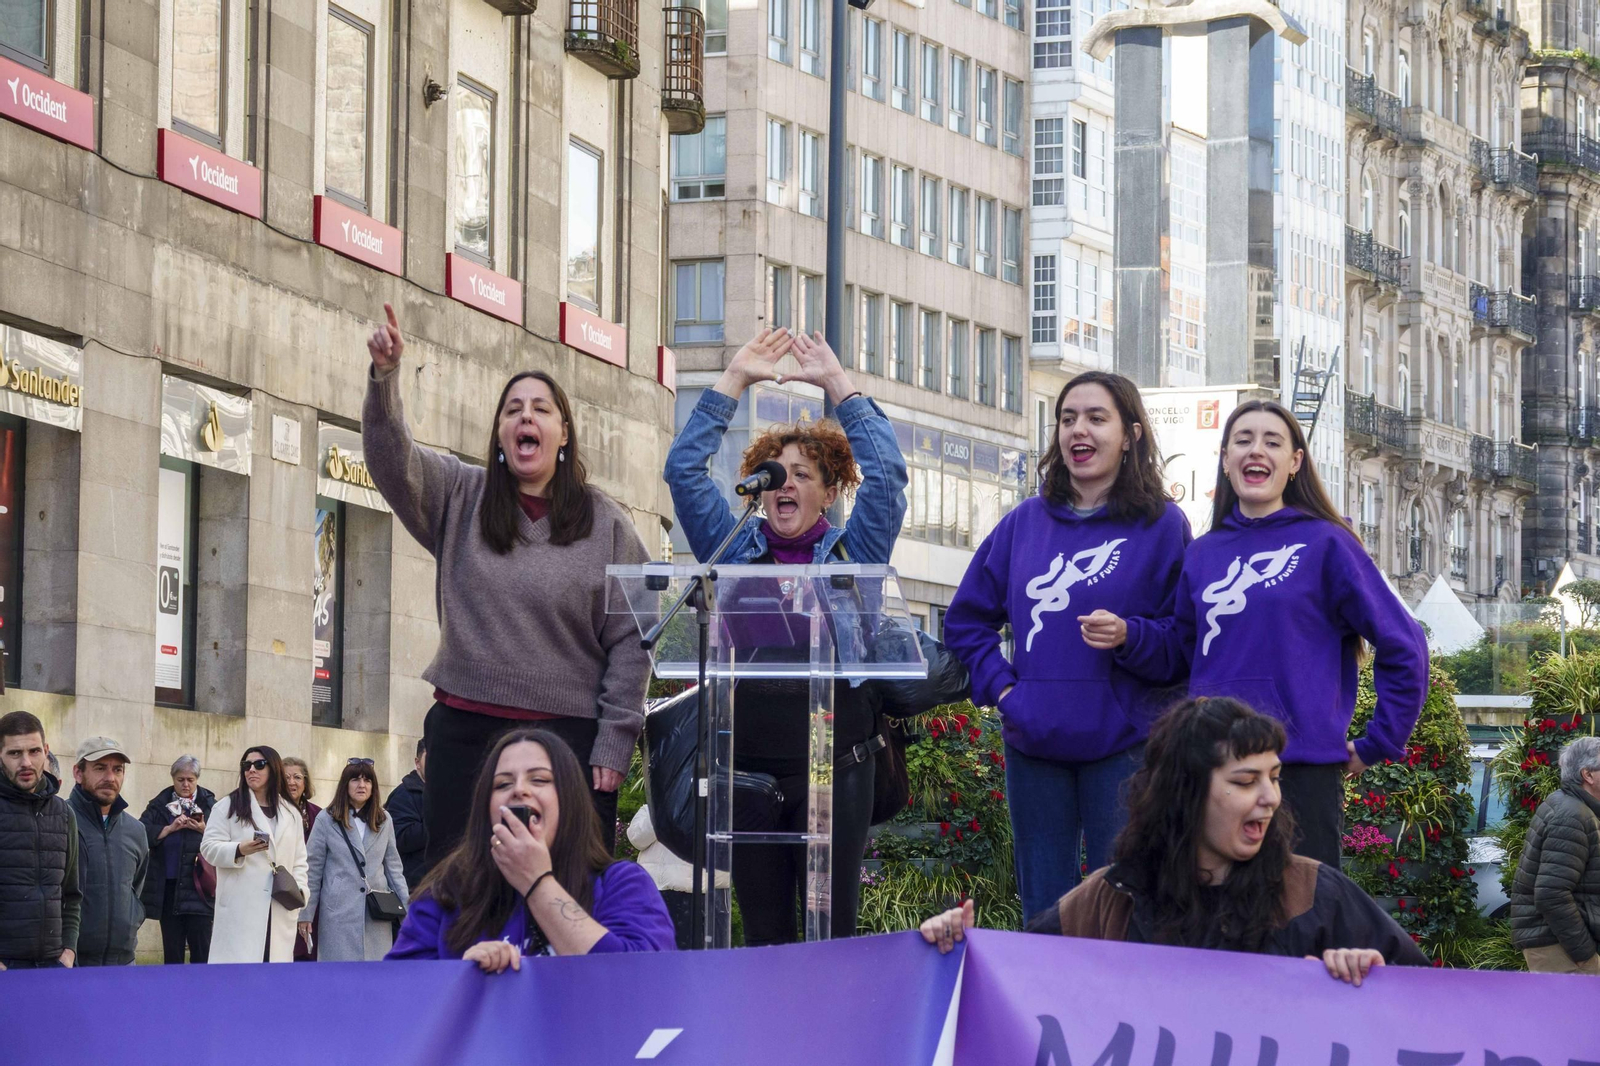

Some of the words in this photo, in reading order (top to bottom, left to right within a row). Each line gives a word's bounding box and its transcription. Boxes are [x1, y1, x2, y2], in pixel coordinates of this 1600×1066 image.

[22, 84, 67, 123] Occident
[201, 161, 239, 195] Occident
[351, 225, 383, 255] Occident
[478, 278, 506, 306] Occident
[588, 325, 612, 350] Occident
[8, 359, 84, 407] Santander
[1148, 407, 1190, 415] ONCELLO
[1163, 416, 1185, 424] VIGO
[944, 442, 969, 460] OCASO
[341, 456, 376, 488] Santa
[1087, 576, 1098, 586] AS
[1099, 550, 1120, 578] FURIAS
[1265, 579, 1276, 588] AS
[1278, 555, 1299, 581] FURIAS
[313, 593, 332, 626] AS
